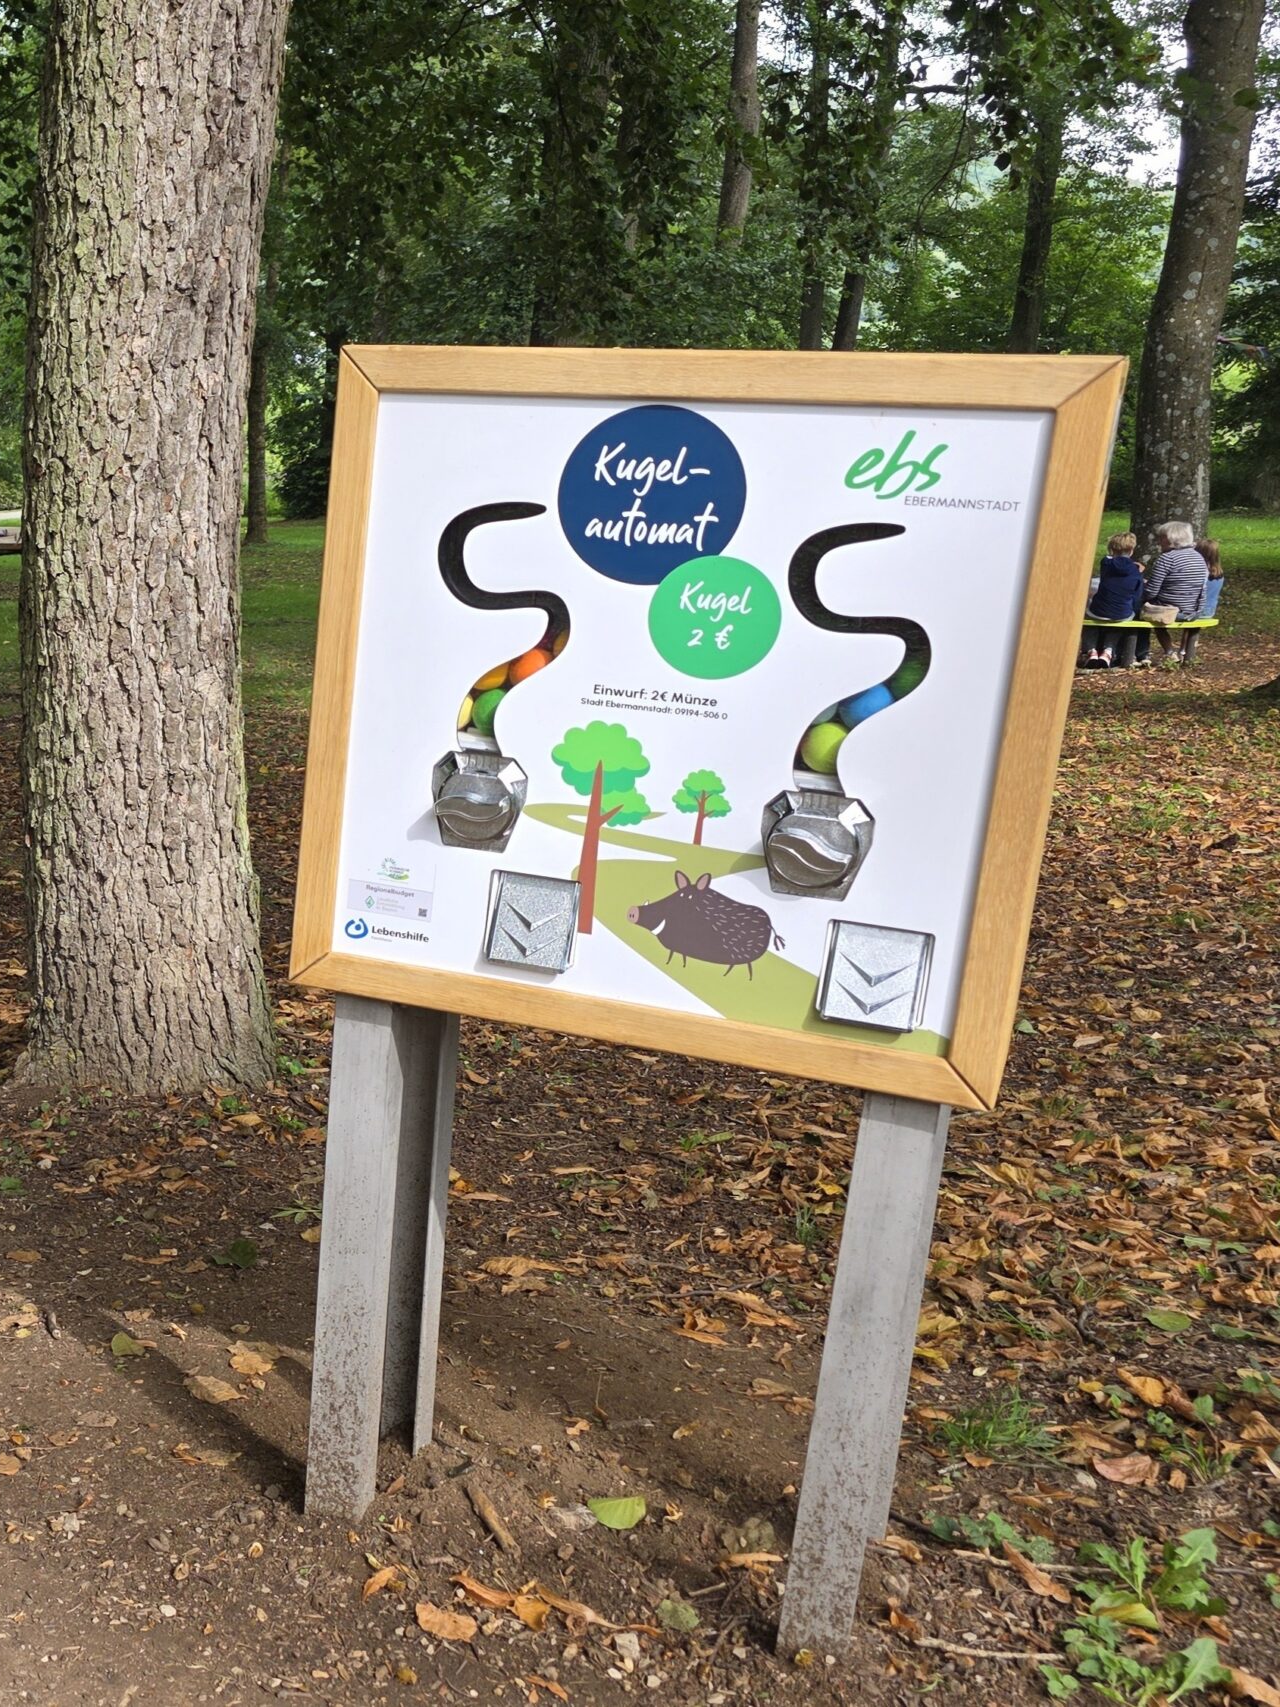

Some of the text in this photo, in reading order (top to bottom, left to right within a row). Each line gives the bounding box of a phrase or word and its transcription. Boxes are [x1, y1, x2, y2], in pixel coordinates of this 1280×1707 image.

[594, 442, 711, 496] Kugel-
[844, 430, 949, 500] ebs
[903, 495, 1021, 513] EBERMANNSTADT
[585, 498, 719, 552] automat
[679, 580, 753, 623] Kugel
[687, 625, 732, 650] 2 €
[593, 684, 718, 707] Einwurf: 2€ Münze
[580, 697, 728, 720] Stadt Ebermannstadt: 09194-506 0
[371, 925, 430, 943] Lebenshilfe
